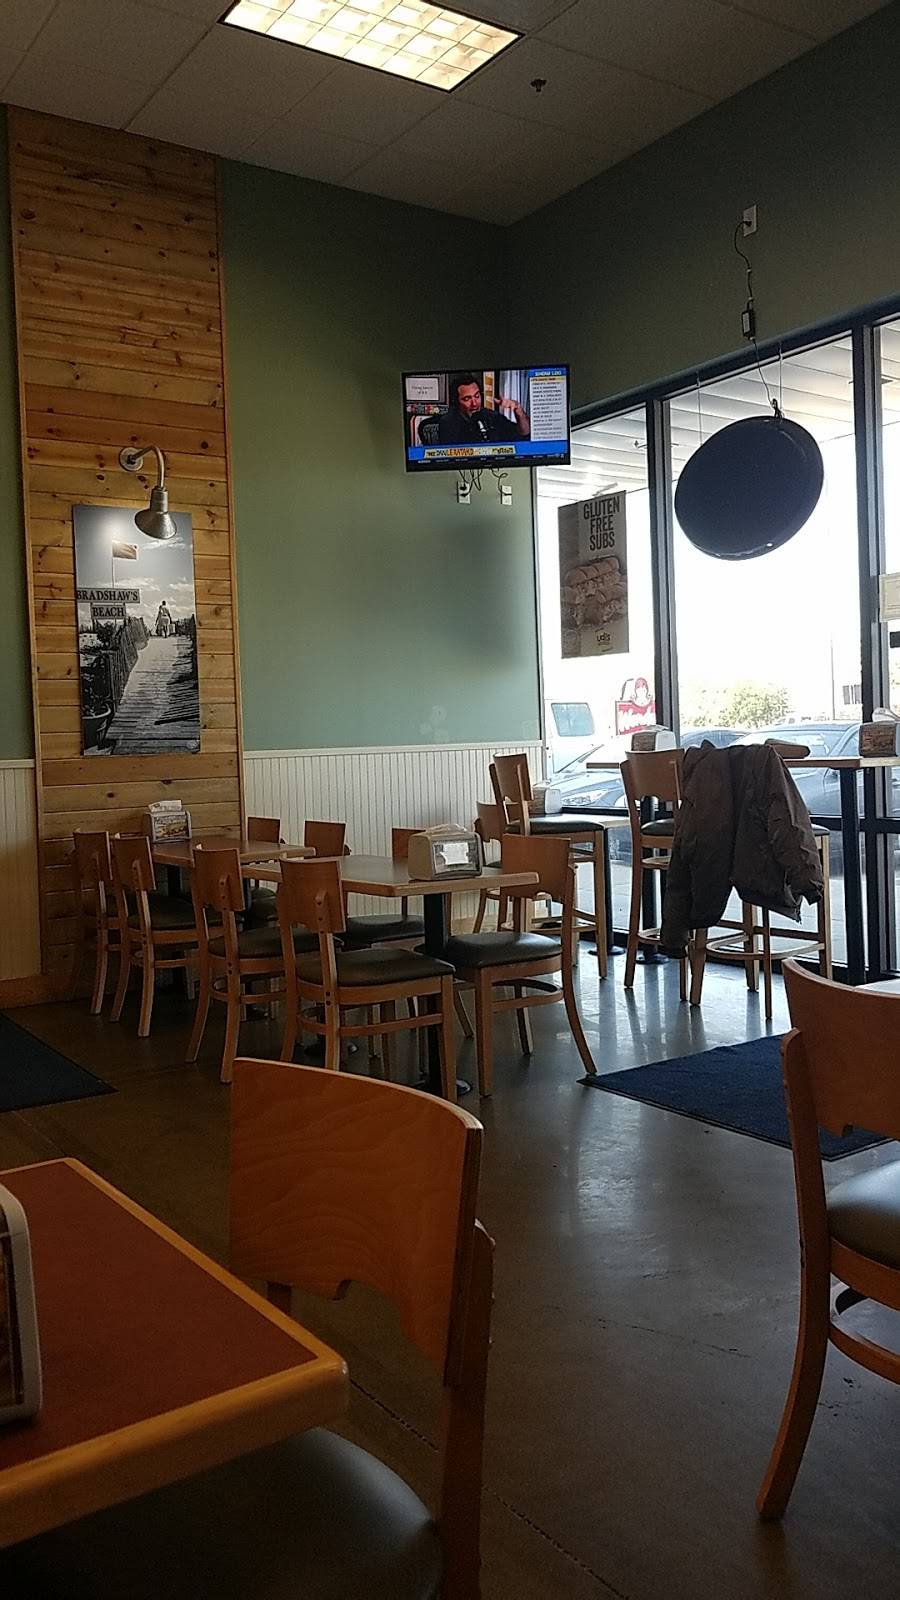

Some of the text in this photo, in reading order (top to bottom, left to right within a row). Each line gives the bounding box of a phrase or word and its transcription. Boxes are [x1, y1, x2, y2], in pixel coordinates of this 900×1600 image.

[583, 495, 621, 520] GLUTEN
[590, 514, 614, 535] FREE
[589, 531, 615, 551] SUBS
[77, 590, 138, 601] BRADSHAW'S
[92, 606, 125, 617] BEACH
